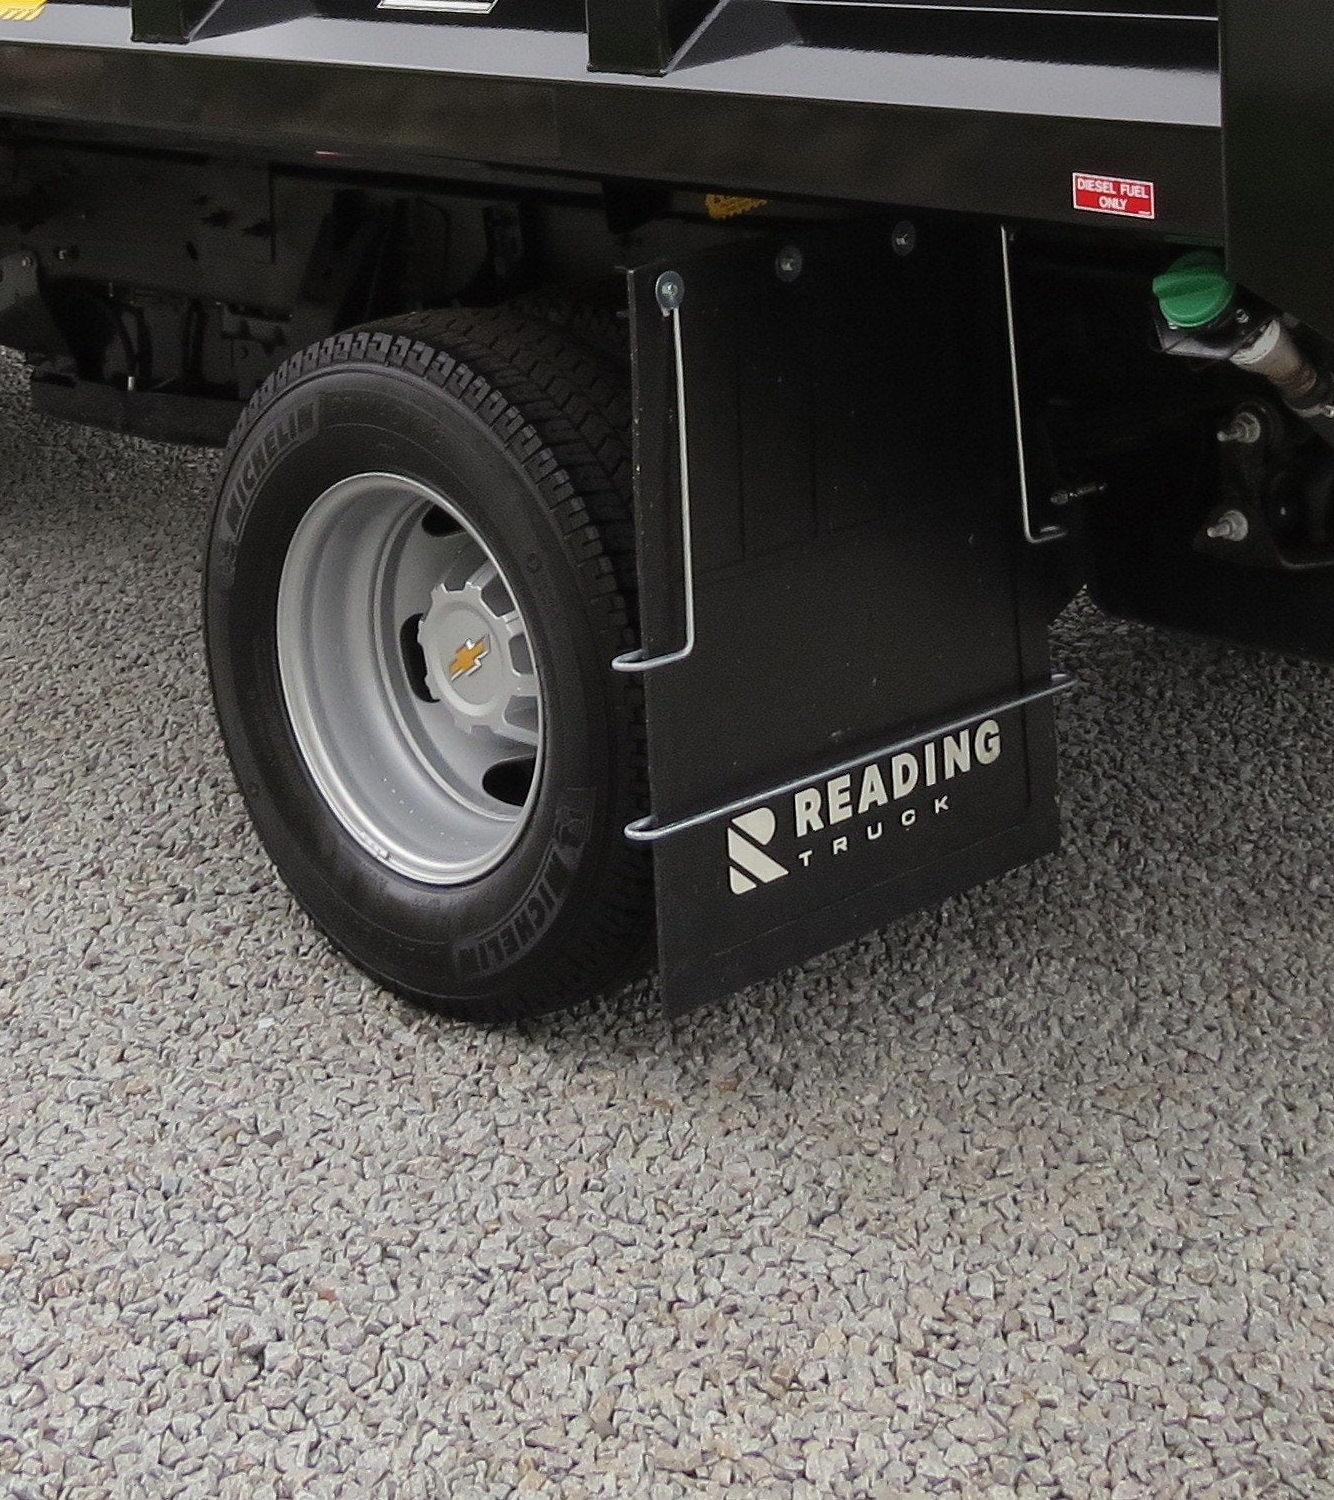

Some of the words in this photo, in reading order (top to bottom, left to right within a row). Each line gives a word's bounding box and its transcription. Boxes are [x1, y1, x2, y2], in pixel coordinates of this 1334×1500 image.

[1077, 177, 1117, 195] DIESEL
[1120, 183, 1149, 199] FUEL
[1098, 195, 1128, 211] ONLY
[794, 719, 1002, 838] READING
[798, 795, 950, 867] TRUCK
